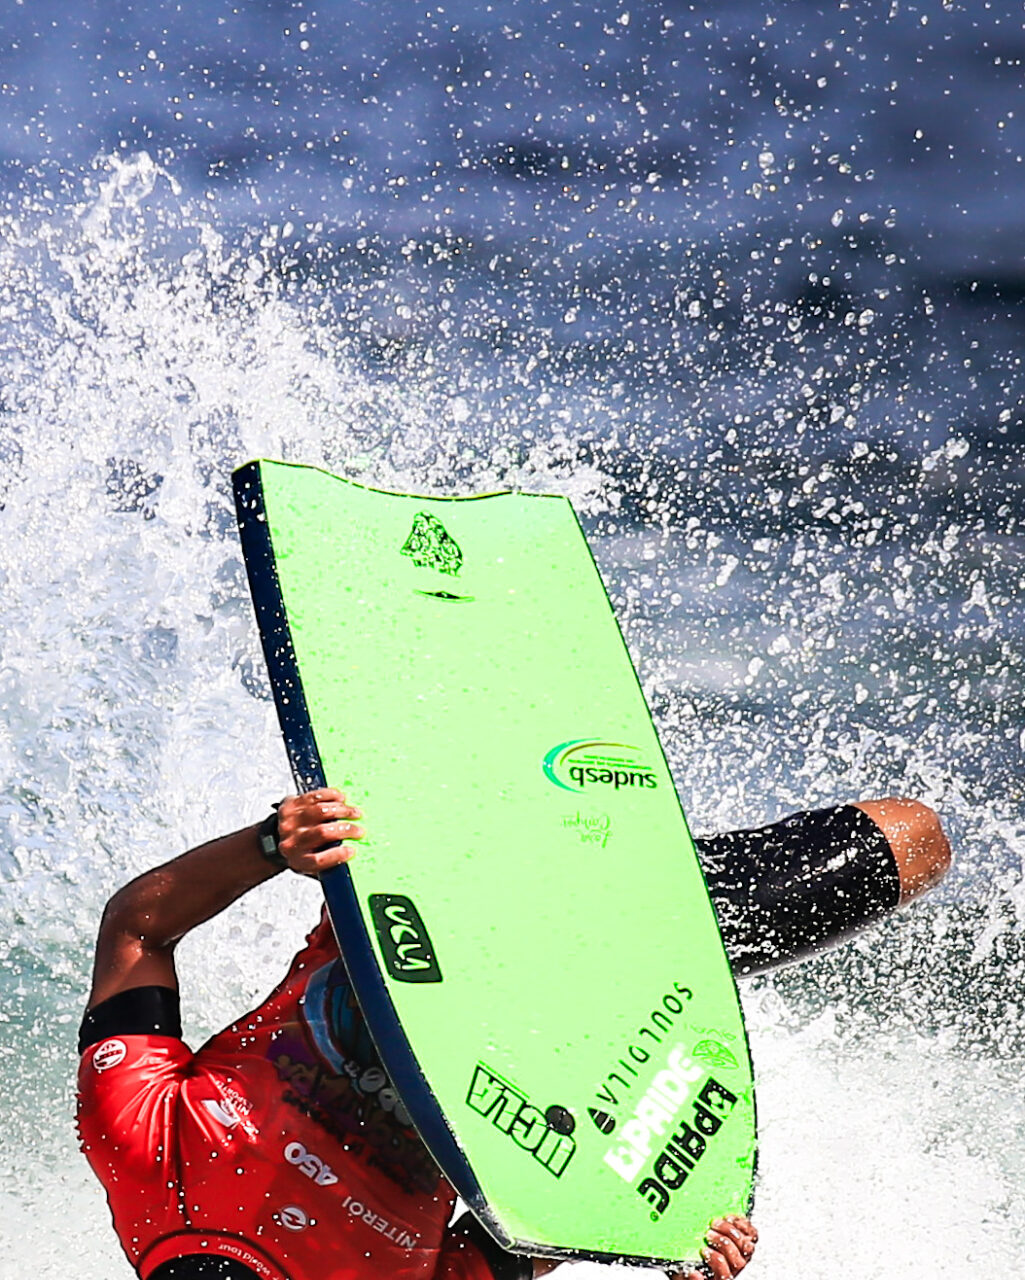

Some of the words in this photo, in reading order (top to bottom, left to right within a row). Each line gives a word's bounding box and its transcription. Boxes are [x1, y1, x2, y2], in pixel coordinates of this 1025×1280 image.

[569, 766, 657, 790] sudesb
[465, 1064, 577, 1178] UCLA
[284, 1142, 339, 1186] 450
[636, 1098, 724, 1215] PRIDE
[341, 1195, 416, 1250] NITERÓI
[218, 1243, 243, 1258] tour
[242, 1252, 271, 1277] world
